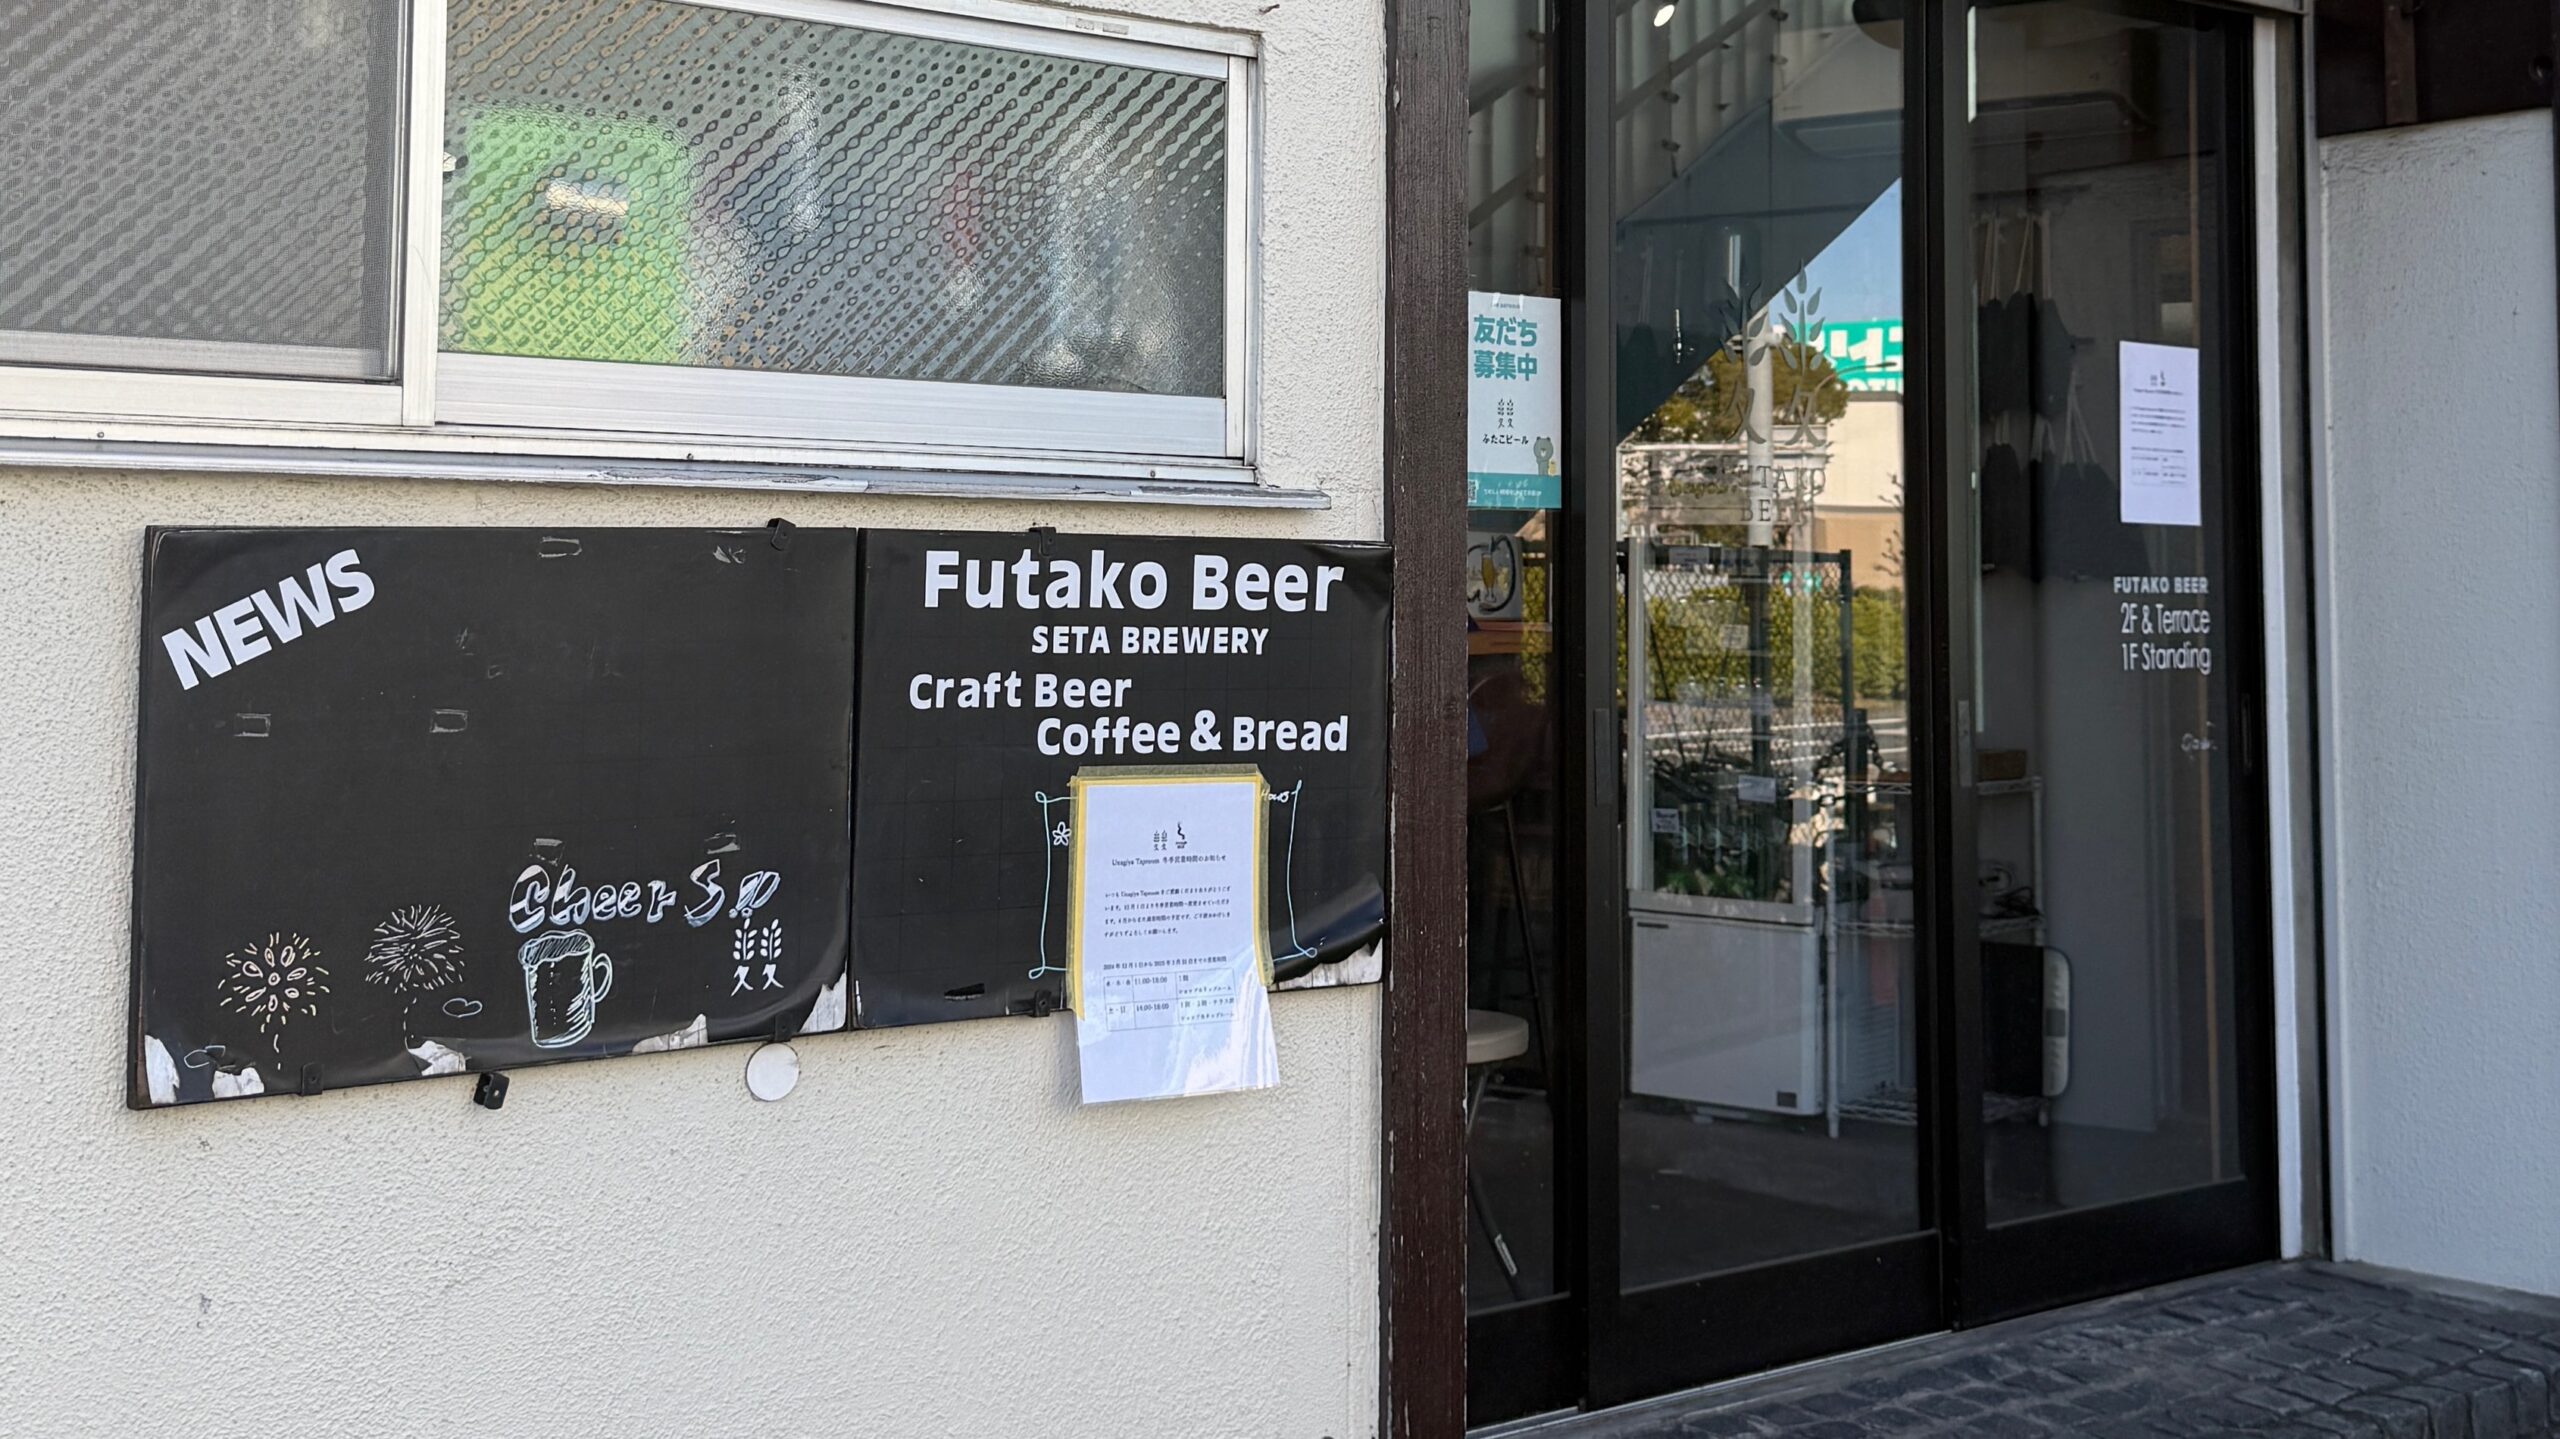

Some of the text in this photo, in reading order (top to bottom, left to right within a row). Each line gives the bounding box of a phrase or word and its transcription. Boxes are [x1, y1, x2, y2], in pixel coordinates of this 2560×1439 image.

[1474, 314, 1537, 347] 友だち
[1474, 350, 1537, 381] 募集中
[1483, 433, 1529, 445] ふたこビール
[924, 549, 1344, 612] Futako Beer
[2113, 576, 2208, 593] FUTAKO BEER
[161, 549, 375, 690] NEWS
[2120, 602, 2210, 634] 2F & Terrace
[1032, 626, 1269, 655] SETA BREWERY
[2122, 641, 2211, 675] 1F Standing
[909, 671, 1132, 709] Craft Beer
[1037, 710, 1348, 755] Coffee & Bread
